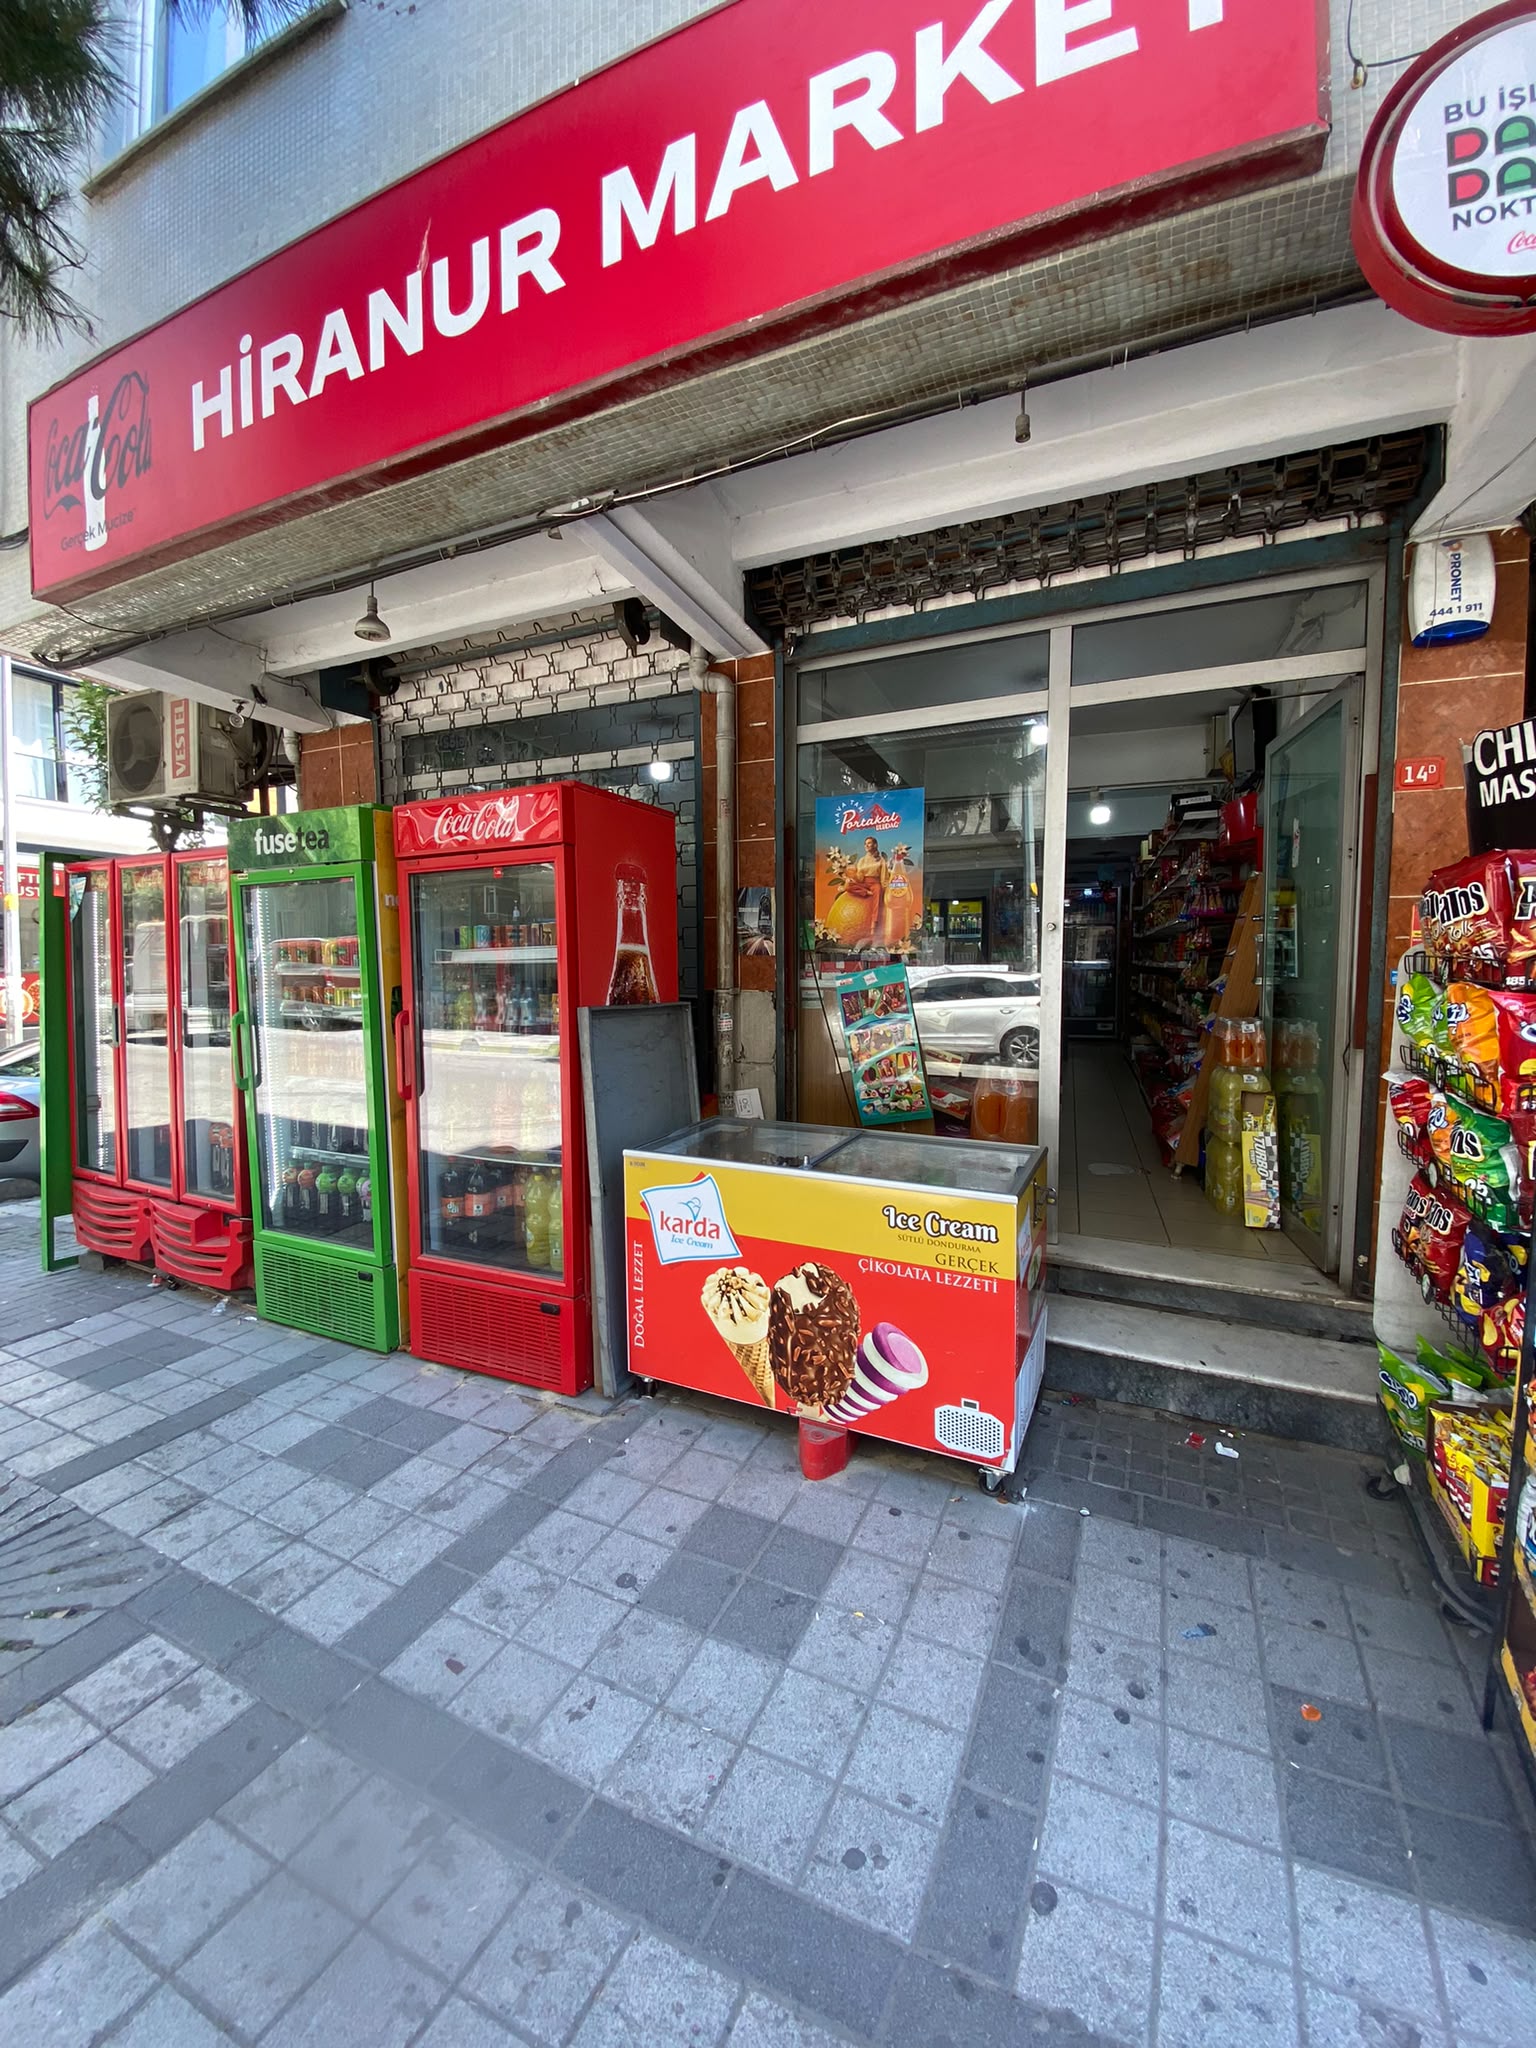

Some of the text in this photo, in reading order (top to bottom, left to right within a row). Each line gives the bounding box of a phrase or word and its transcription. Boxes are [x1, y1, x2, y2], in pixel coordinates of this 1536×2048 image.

[1444, 96, 1486, 125] BU
[191, 0, 1224, 452] HİRANUR MARKE
[60, 525, 96, 551] Gerçek
[1450, 552, 1463, 602] PRONET
[1429, 607, 1454, 618] 444
[1465, 602, 1483, 613] 911
[174, 699, 188, 777] VESTEL
[1479, 768, 1536, 808] MAS
[841, 809, 899, 833] Portakal
[1253, 1135, 1269, 1178] TURBO
[660, 1211, 720, 1240] karda
[882, 1205, 999, 1244] Ice Cream
[671, 1235, 714, 1250] Ice Cream
[898, 1234, 981, 1253] SÜTLÜ DONDURMA
[857, 1257, 999, 1294] ÇİKOLATA LEZZETİ
[935, 1253, 999, 1274] GERÇEK
[633, 1243, 645, 1348] DOĞAL LEZZET
